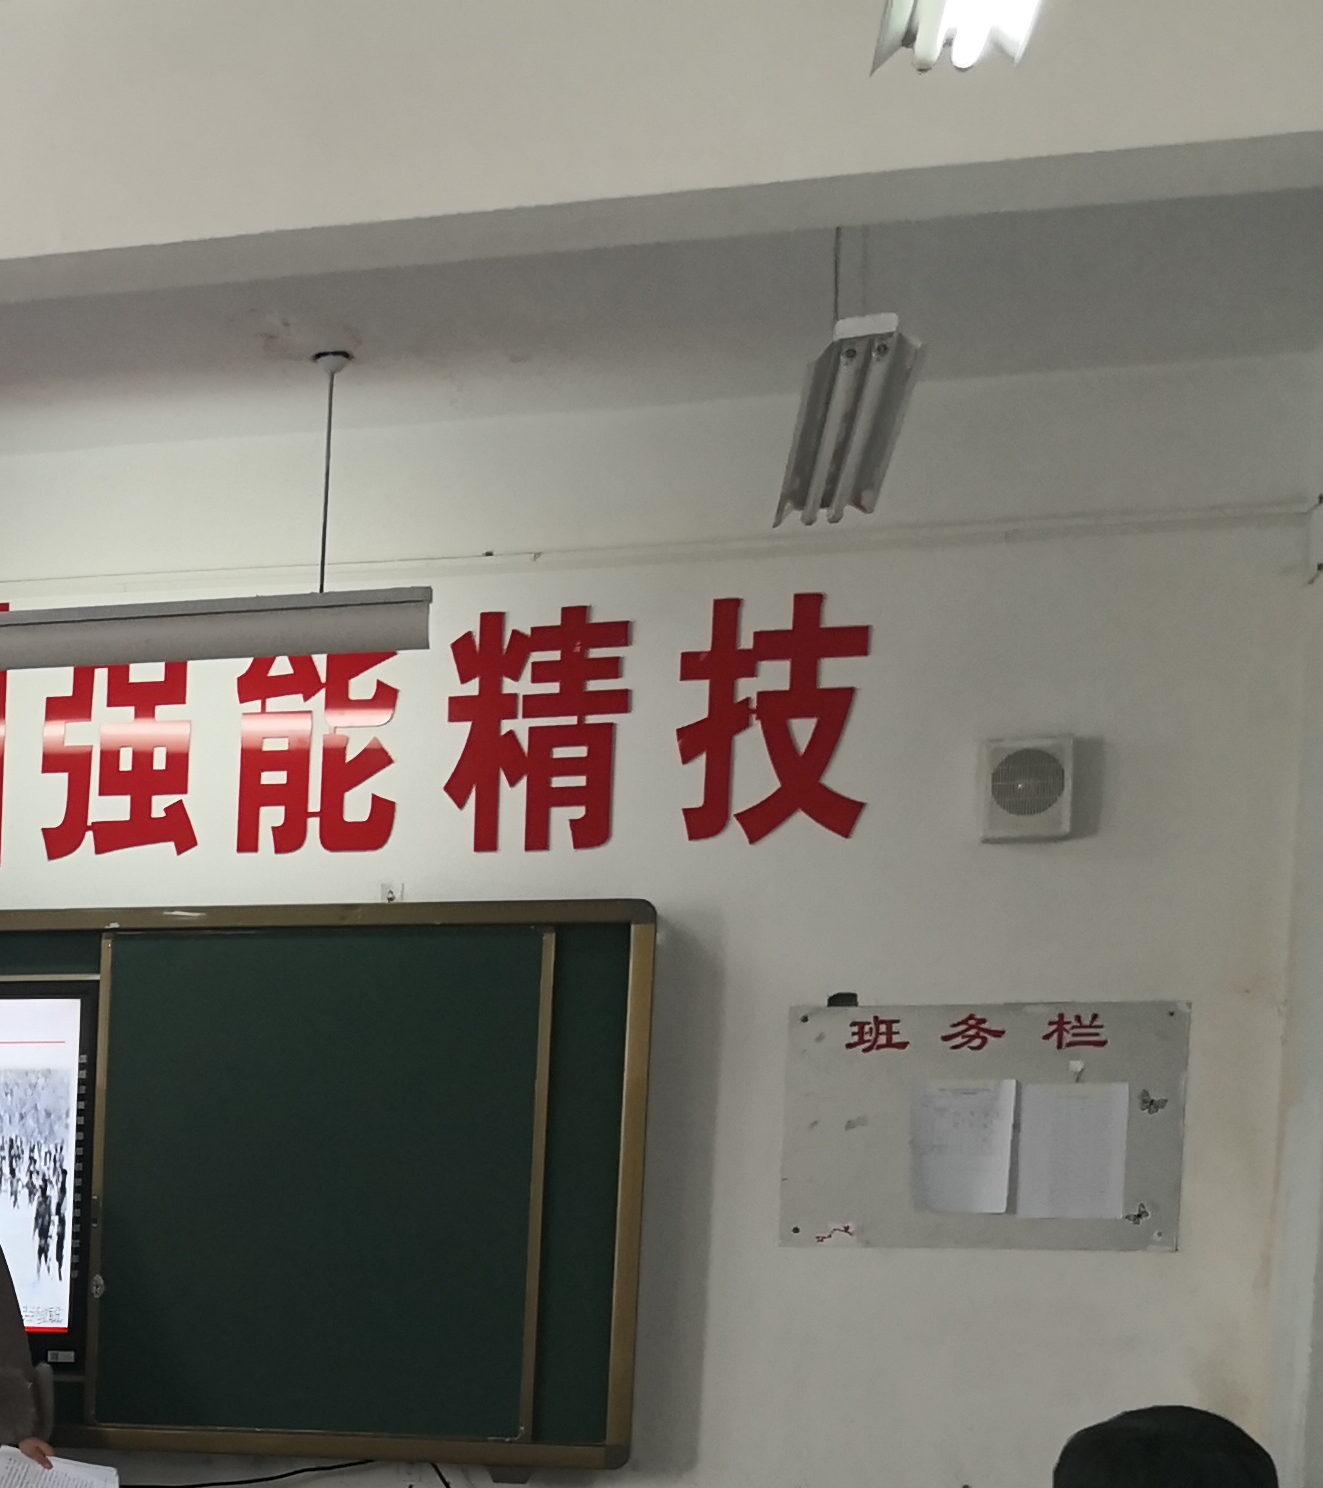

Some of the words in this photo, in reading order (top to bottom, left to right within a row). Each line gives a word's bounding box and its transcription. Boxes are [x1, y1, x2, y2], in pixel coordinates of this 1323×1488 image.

[41, 592, 871, 861] 强能精技
[845, 1012, 1109, 1053] 班务栏
